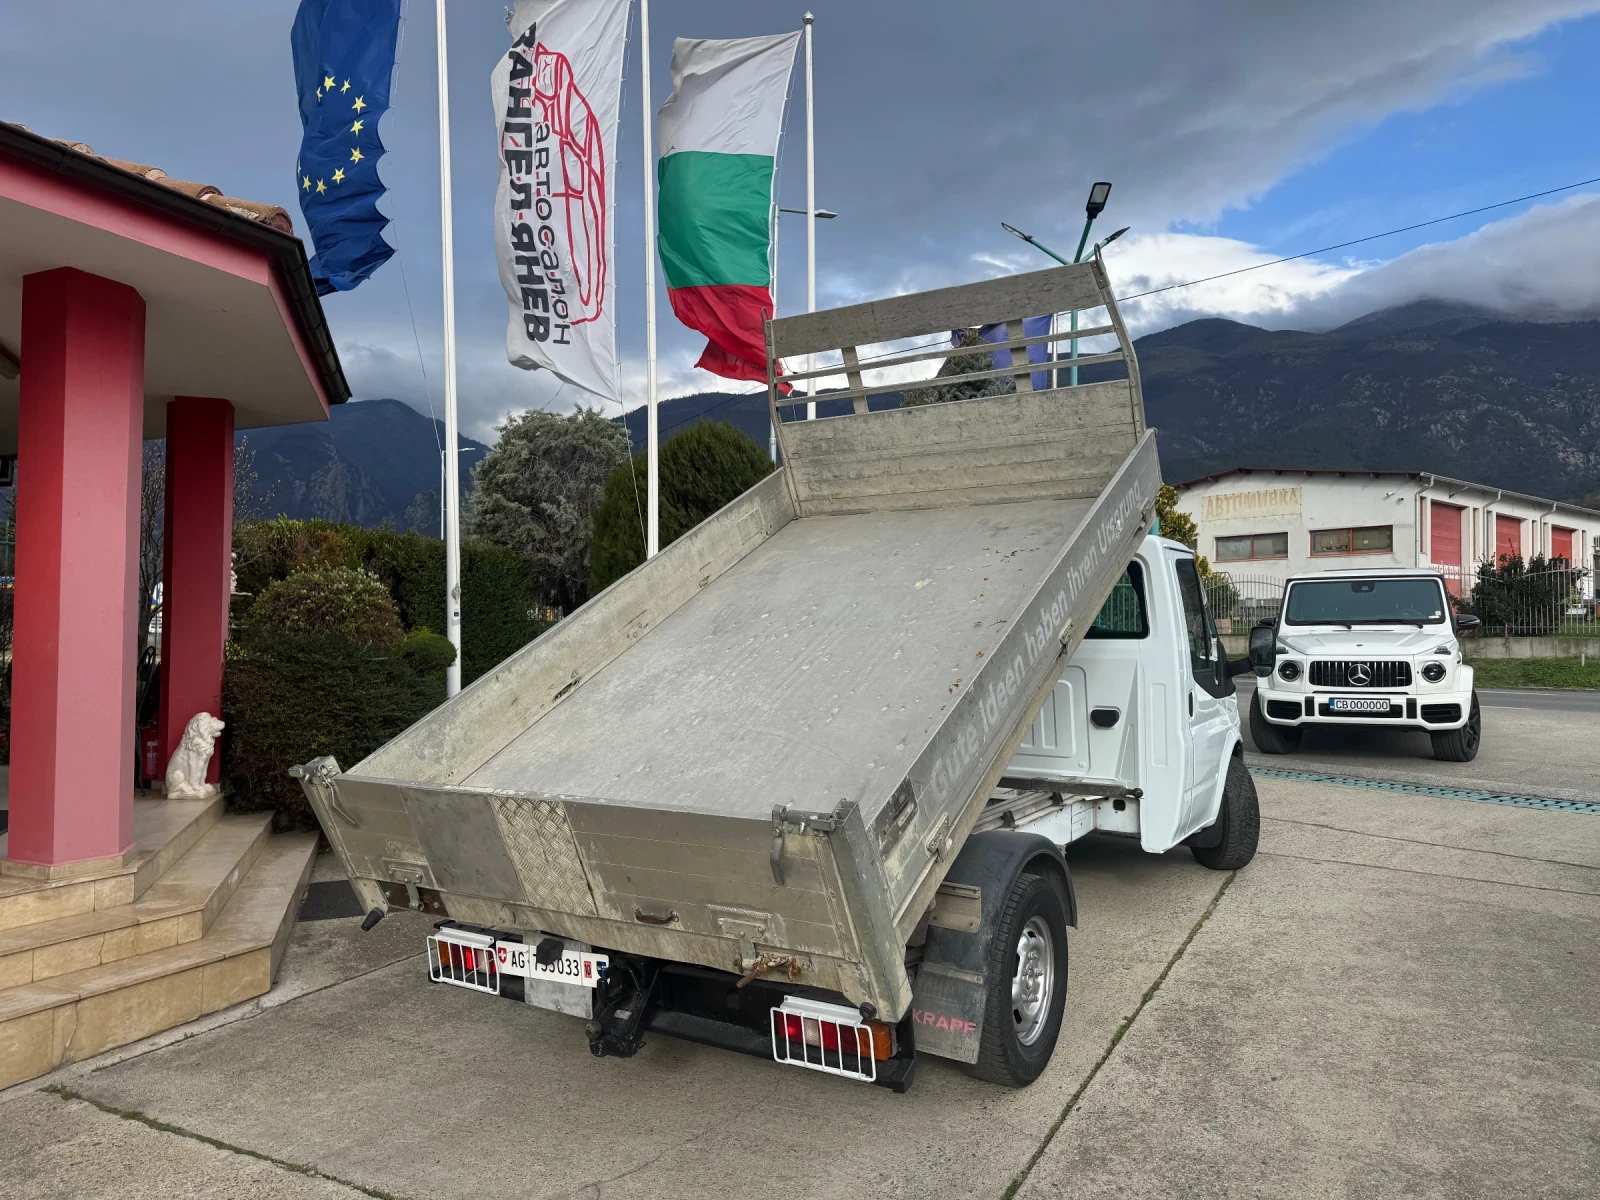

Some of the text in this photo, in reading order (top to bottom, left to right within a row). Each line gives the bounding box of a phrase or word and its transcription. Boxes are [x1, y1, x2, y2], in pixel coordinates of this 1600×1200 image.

[511, 222, 550, 342] ЯНЕВ
[1205, 489, 1299, 520] АВТОМИВКА
[931, 479, 1141, 801] Gute Ideen haben ihren Ursprung
[511, 950, 526, 969] AG
[912, 1008, 977, 1034] KRAPF
